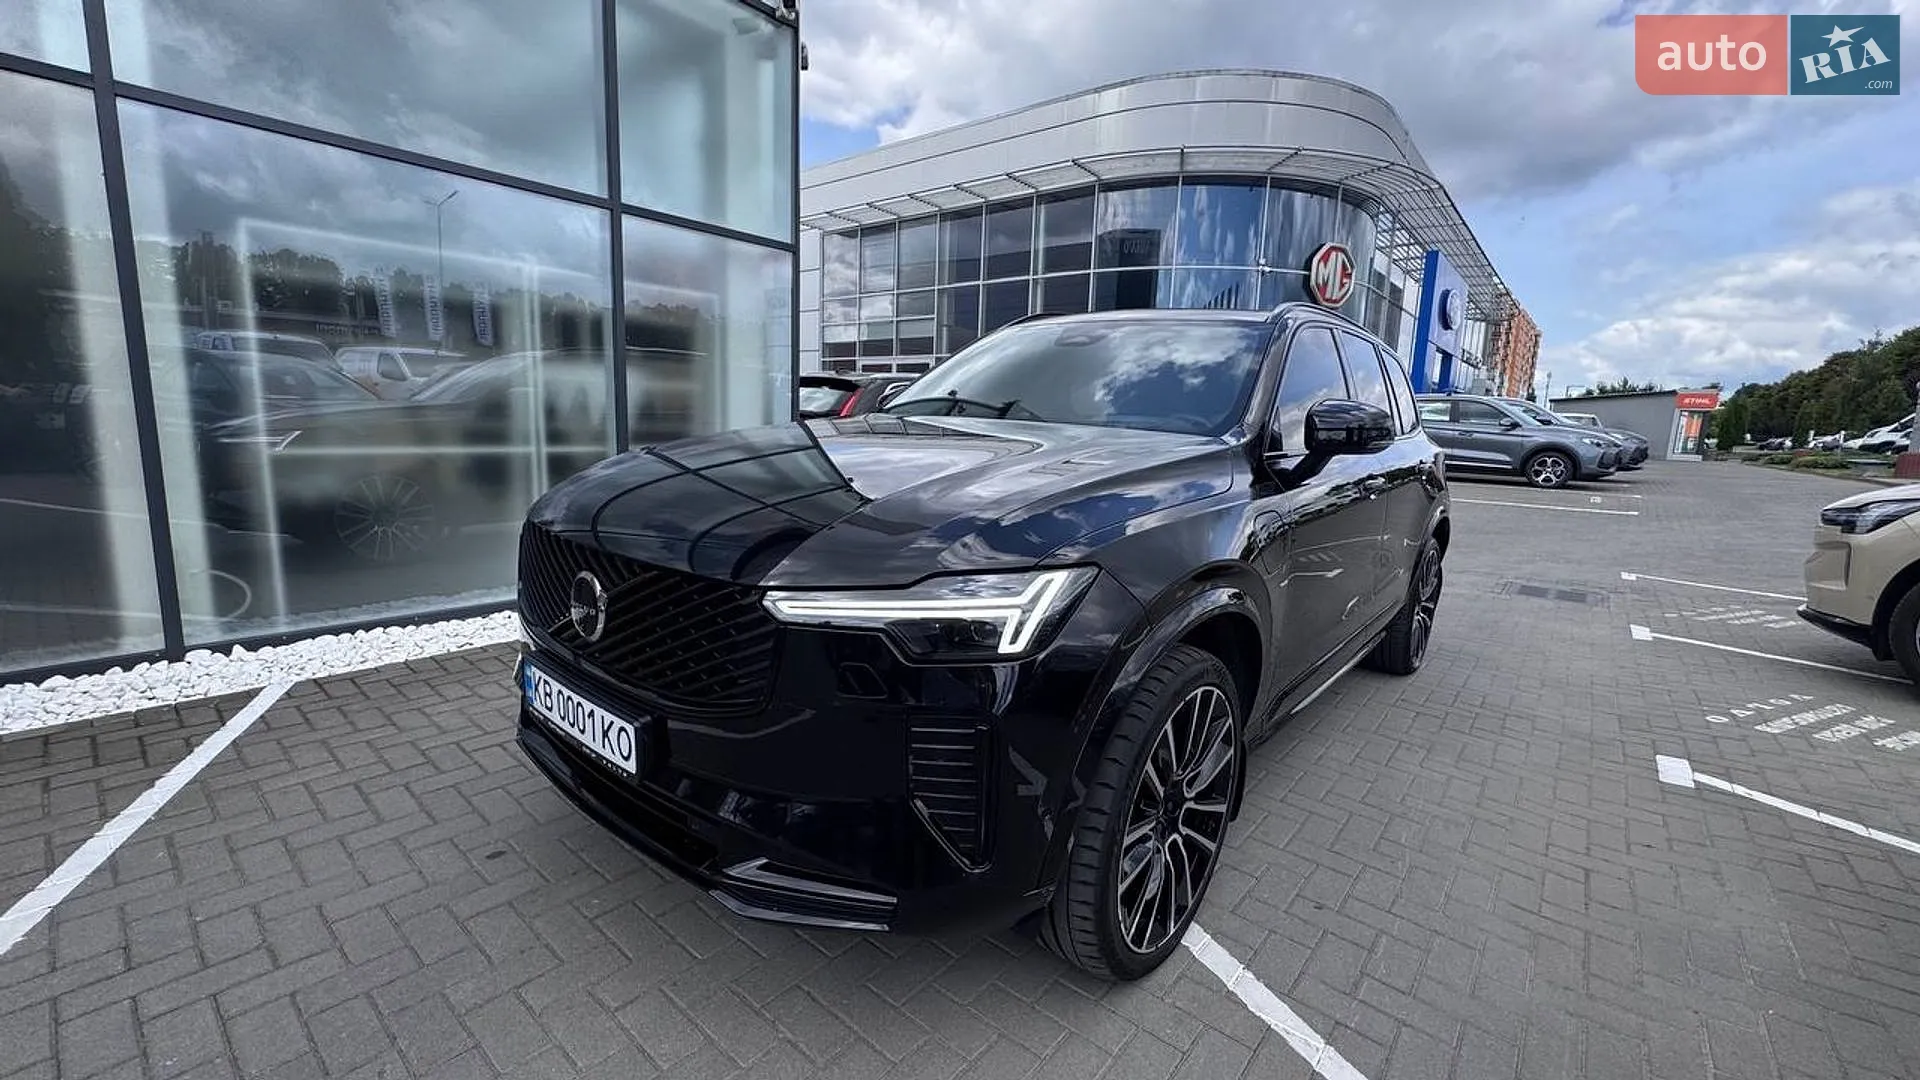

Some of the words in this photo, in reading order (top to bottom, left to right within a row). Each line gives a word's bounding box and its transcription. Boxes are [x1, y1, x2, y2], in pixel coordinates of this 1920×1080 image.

[1316, 251, 1352, 300] MG
[1683, 397, 1712, 405] STIHL
[533, 672, 553, 712] KB
[557, 689, 596, 743] 0001
[601, 715, 632, 762] KO
